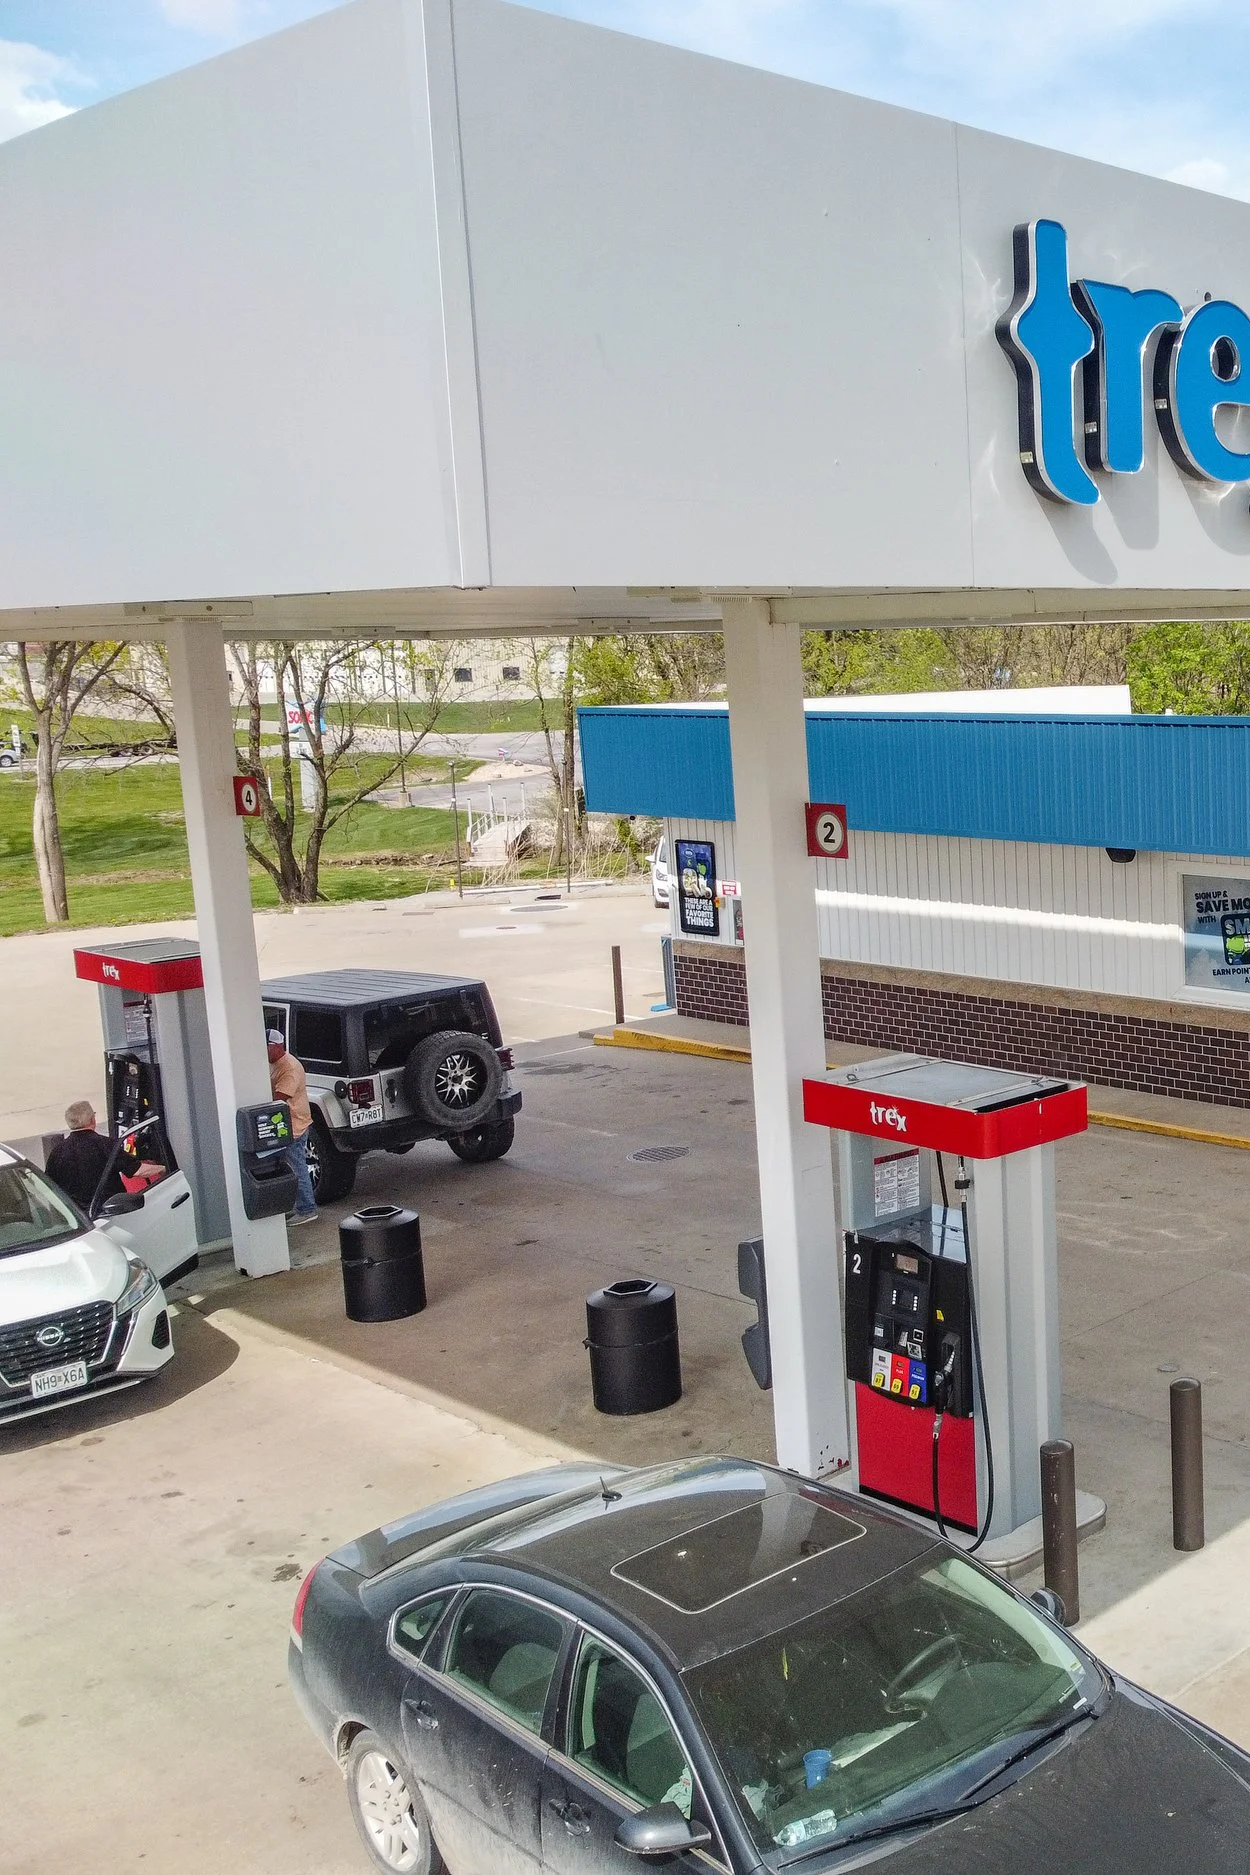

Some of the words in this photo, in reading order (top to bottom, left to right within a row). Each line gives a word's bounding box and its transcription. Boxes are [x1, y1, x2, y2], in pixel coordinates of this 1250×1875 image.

[246, 791, 252, 805] 4
[823, 822, 835, 843] 2
[1195, 892, 1211, 900] SIGN
[1212, 891, 1222, 899] UP
[1222, 890, 1228, 898] &
[1196, 899, 1229, 913] SAVE
[685, 909, 714, 919] FAVORITE
[1197, 915, 1216, 924] WITH
[686, 917, 714, 927] THINGS
[102, 962, 120, 980] trex
[1213, 968, 1231, 976] EARN
[870, 1101, 907, 1132] trex
[853, 1254, 861, 1274] 2
